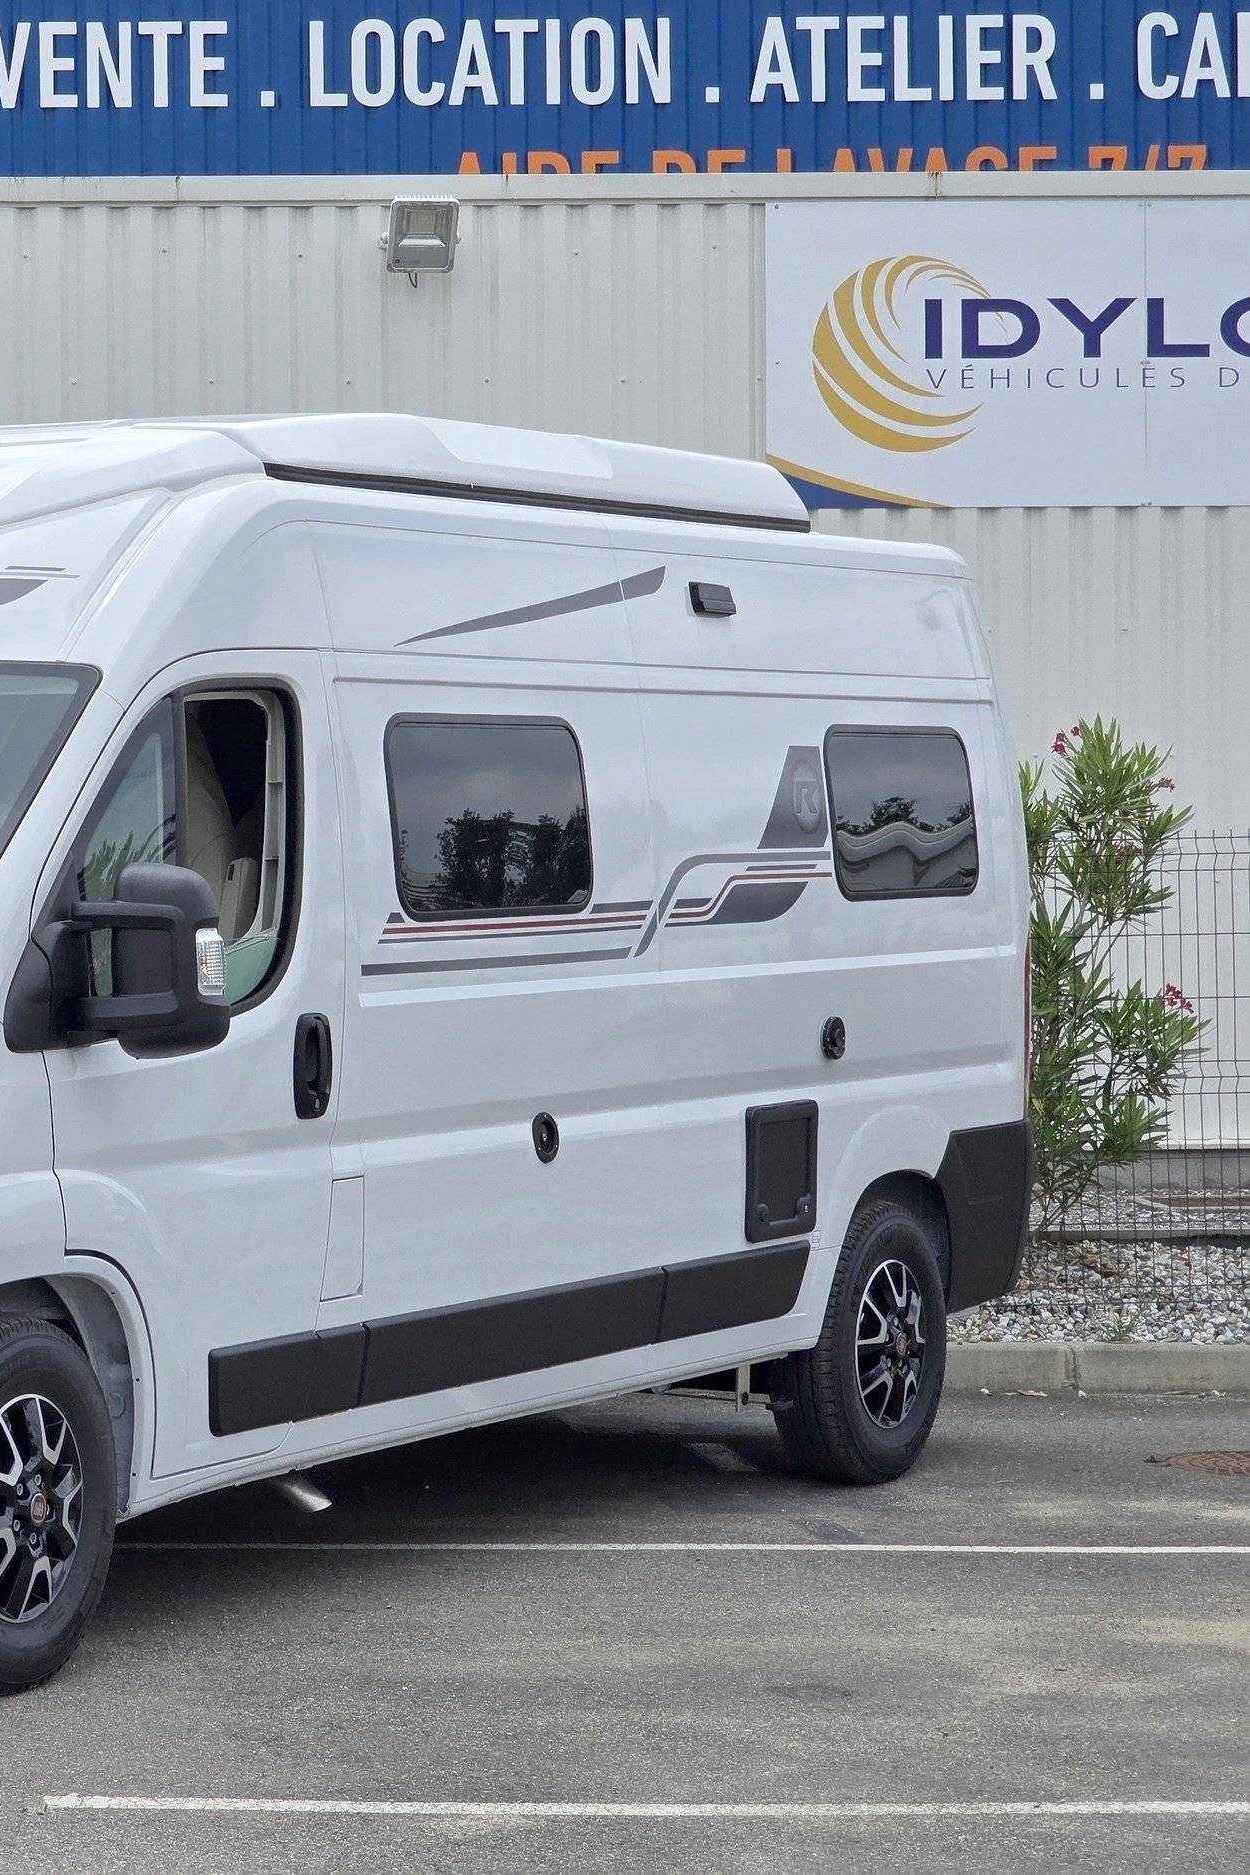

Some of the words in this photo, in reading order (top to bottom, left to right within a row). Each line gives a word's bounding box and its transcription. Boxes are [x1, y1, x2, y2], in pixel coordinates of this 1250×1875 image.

[308, 17, 671, 107] LOCATION
[749, 14, 1059, 104] ATELIER
[926, 363, 1187, 390] VÉHICULES
